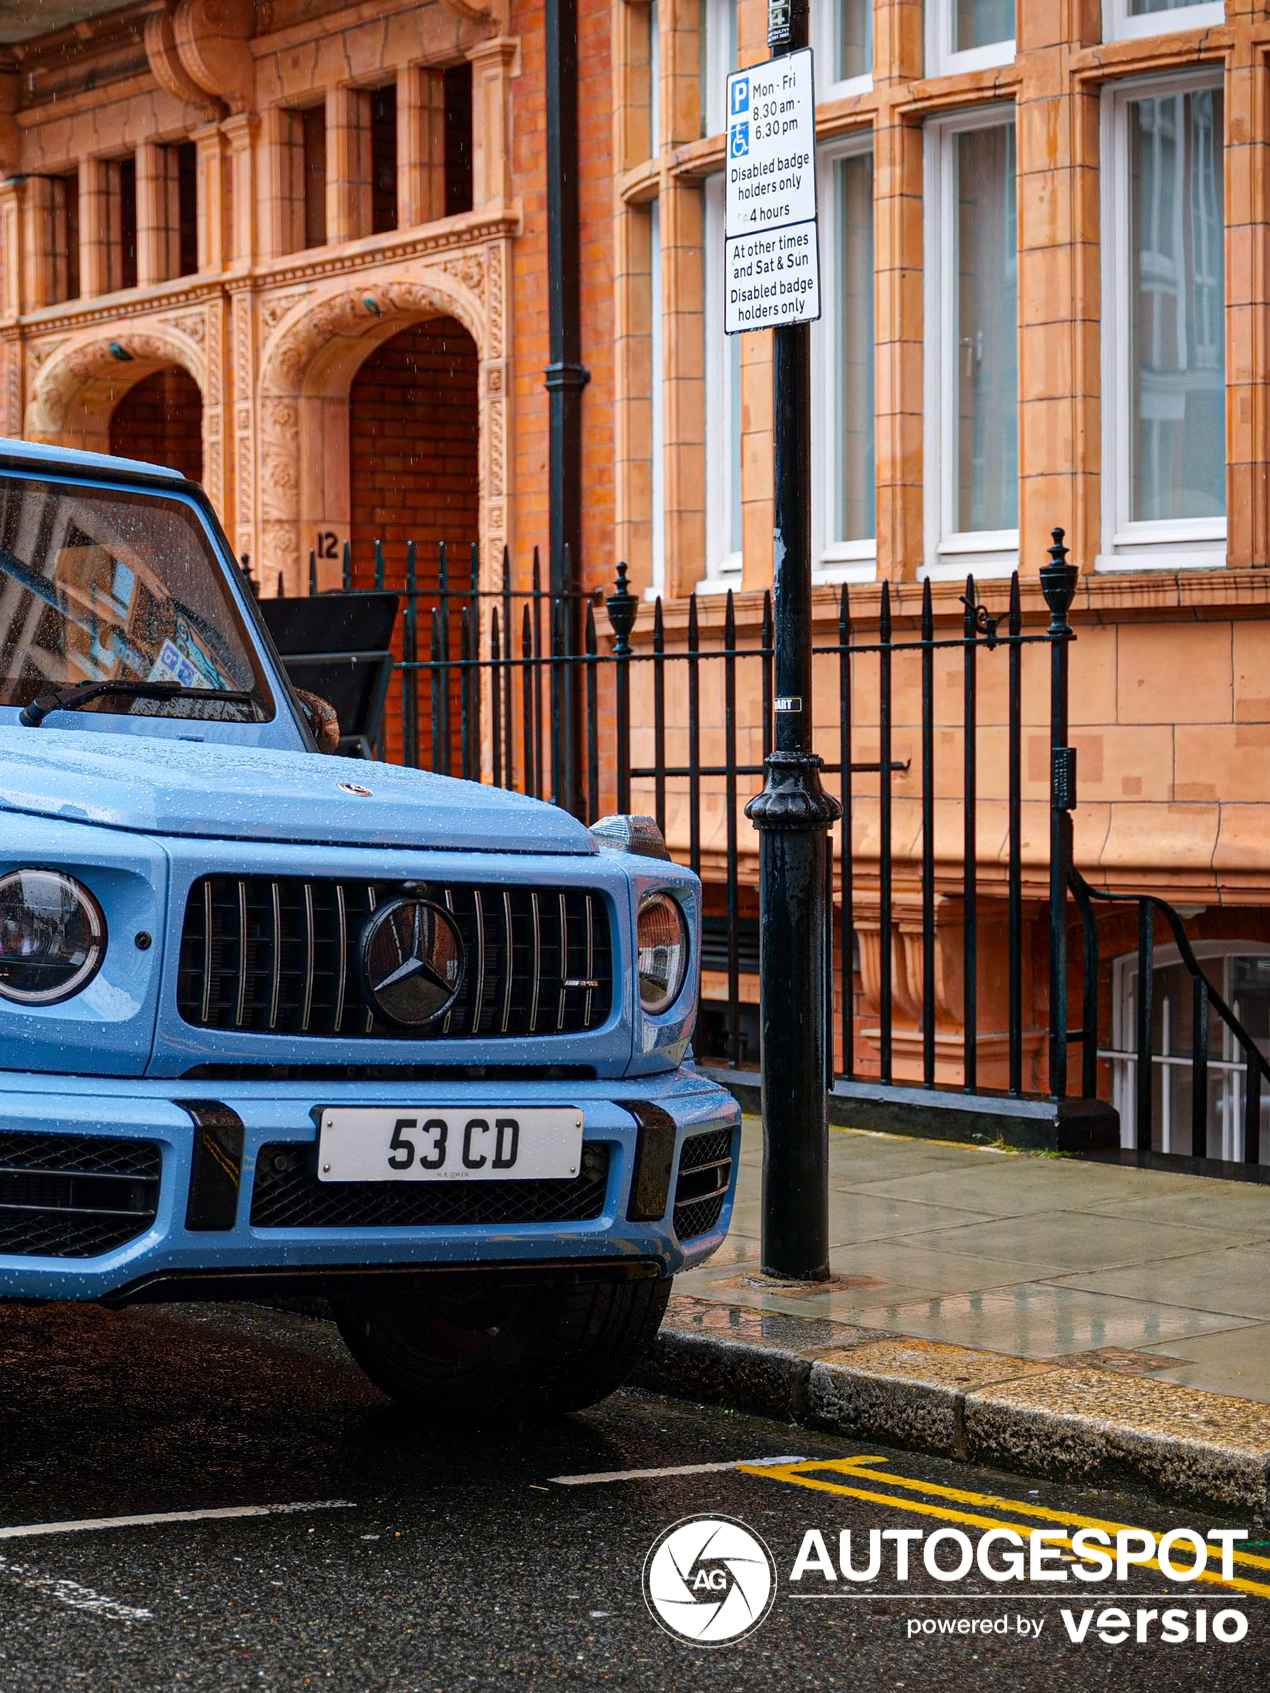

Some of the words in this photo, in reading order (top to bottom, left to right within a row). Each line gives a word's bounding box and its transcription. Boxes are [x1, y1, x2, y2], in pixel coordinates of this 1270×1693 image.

[753, 80, 774, 99] Mon
[783, 72, 796, 90] Fri
[753, 101, 777, 121] 8.30
[780, 99, 794, 115] am
[755, 120, 779, 140] 6.30
[782, 119, 798, 136] pm
[731, 160, 775, 183] Disabled
[777, 152, 809, 173] badge
[738, 180, 776, 200] holders
[779, 172, 802, 193] only
[750, 208, 757, 222] 4
[760, 203, 790, 220] hours
[733, 244, 745, 260] At
[748, 239, 776, 257] other
[779, 232, 808, 251] times
[734, 260, 753, 279] and
[756, 257, 775, 275] Sat
[777, 255, 784, 269] &
[787, 252, 809, 269] Sun
[730, 282, 776, 303] Disabled
[779, 276, 814, 296] badge
[738, 300, 778, 321] holders
[780, 298, 805, 318] only
[317, 531, 338, 559] 12
[388, 1119, 448, 1169] 53
[462, 1119, 519, 1169] CD
